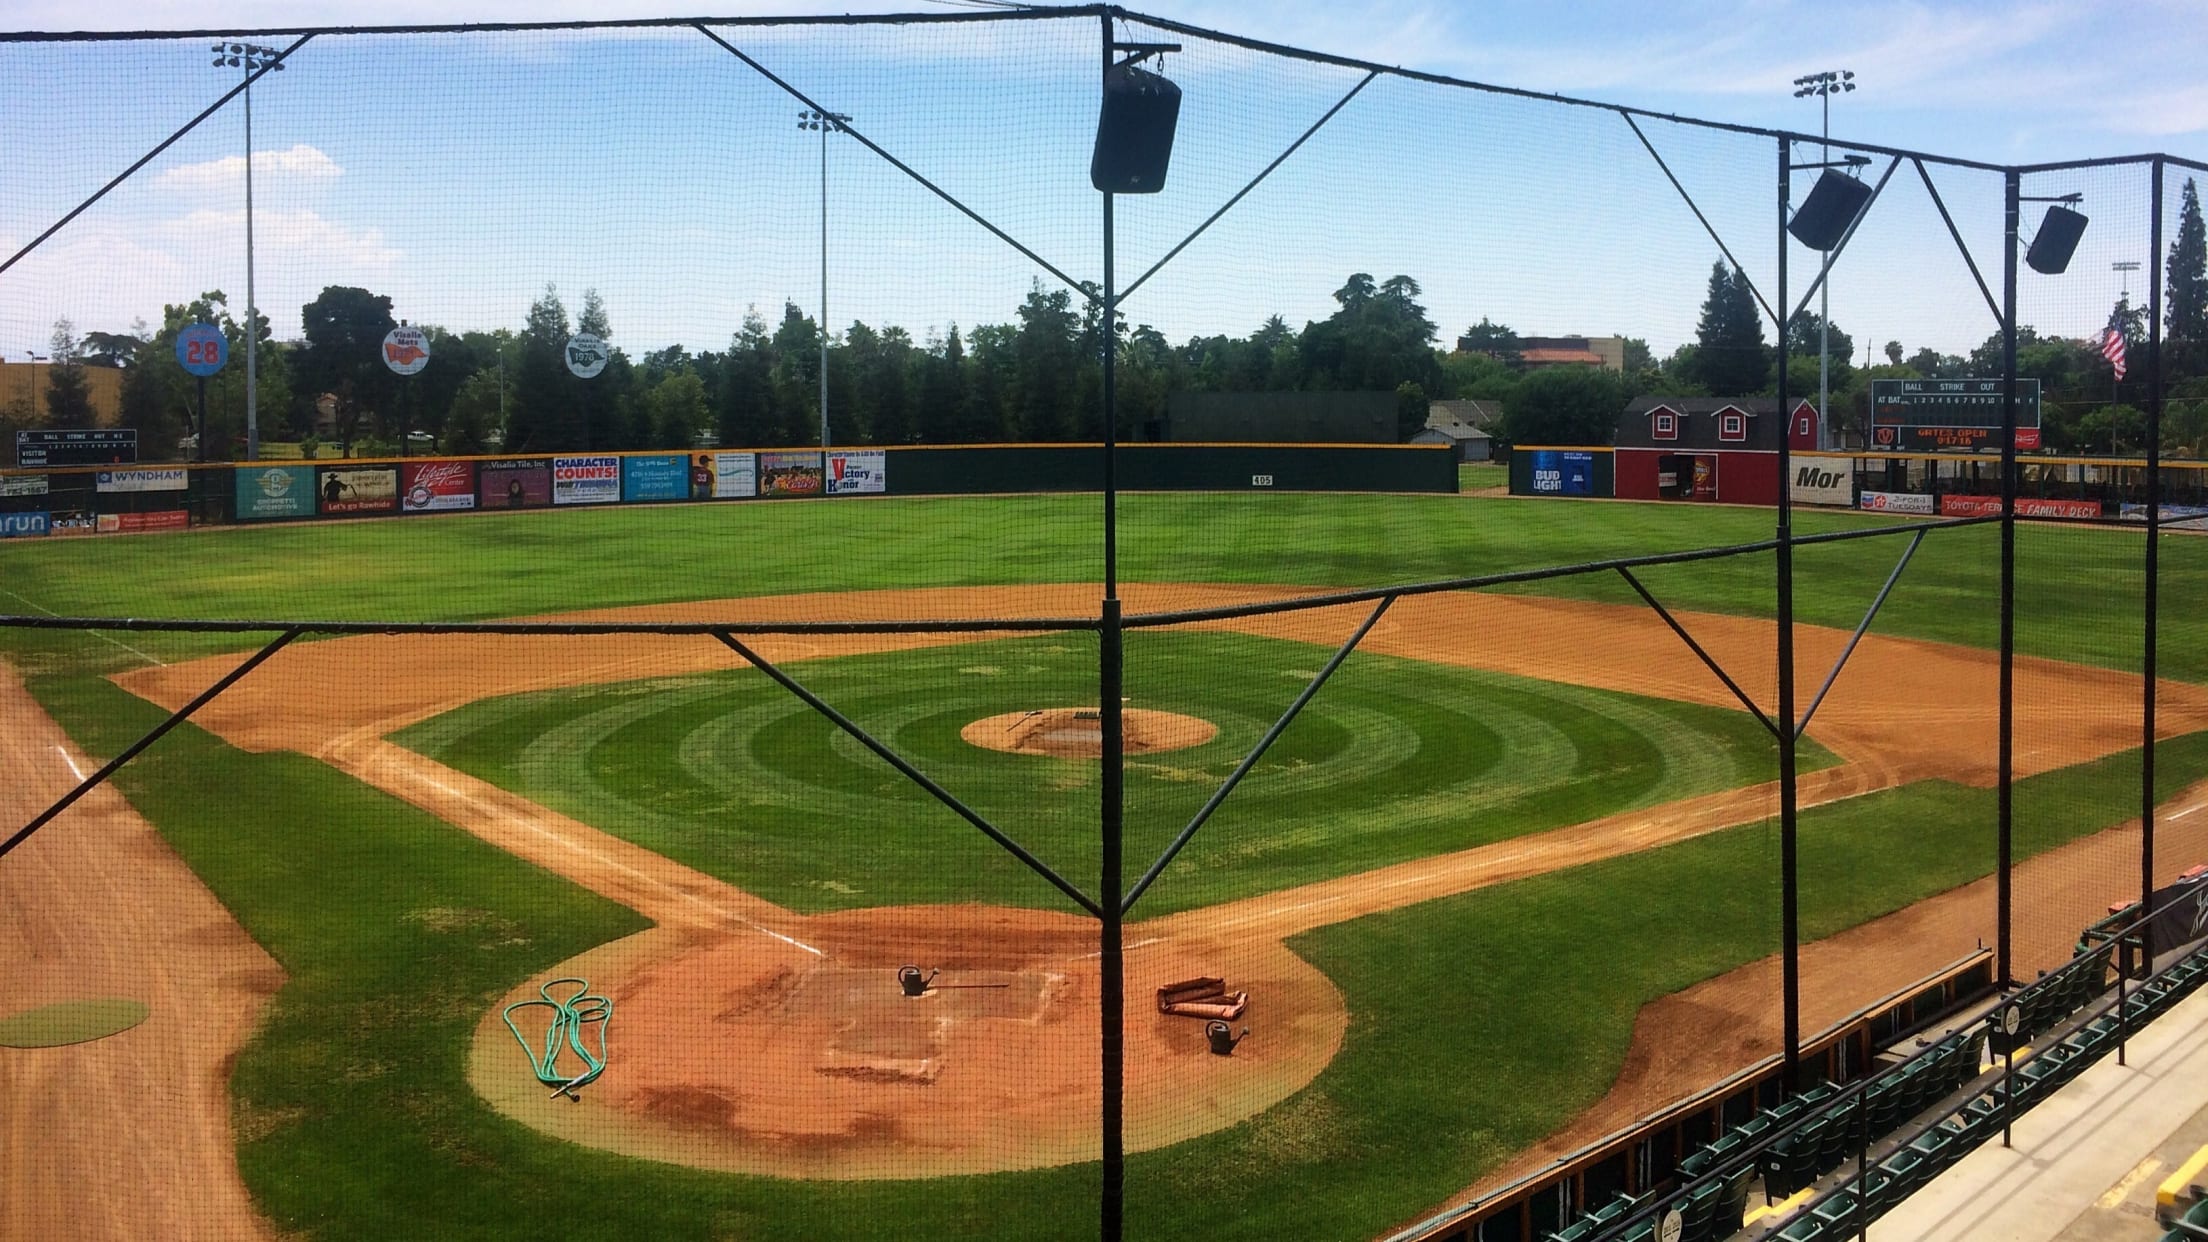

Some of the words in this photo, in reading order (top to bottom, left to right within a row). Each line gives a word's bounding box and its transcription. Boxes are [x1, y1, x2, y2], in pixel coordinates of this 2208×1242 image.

[187, 340, 219, 364] 28
[1905, 383, 1922, 391] BALL
[1940, 383, 1965, 391] STRIKE
[1980, 383, 1995, 391] OUT
[1878, 396, 1886, 404] AT
[1888, 396, 1901, 404] BAT
[1957, 429, 1988, 438] OPEN
[491, 461, 516, 469] Visalia
[555, 458, 618, 468] CHARACTER
[115, 471, 184, 481] WYNDHAM
[414, 462, 468, 484] Lifestyle
[556, 466, 618, 479] COUNTS!
[1535, 470, 1560, 480] BUD
[1796, 466, 1845, 489] Mor
[1254, 476, 1272, 485] 405
[1533, 479, 1562, 490] LIGHT
[328, 503, 347, 511] Let's
[347, 503, 358, 511] go
[359, 501, 391, 509] Rawhide
[1887, 502, 1933, 512] TUESDAYS
[1946, 501, 1980, 511] TOYOTA
[2026, 503, 2066, 517] FAMILY
[2069, 506, 2097, 518] DECK
